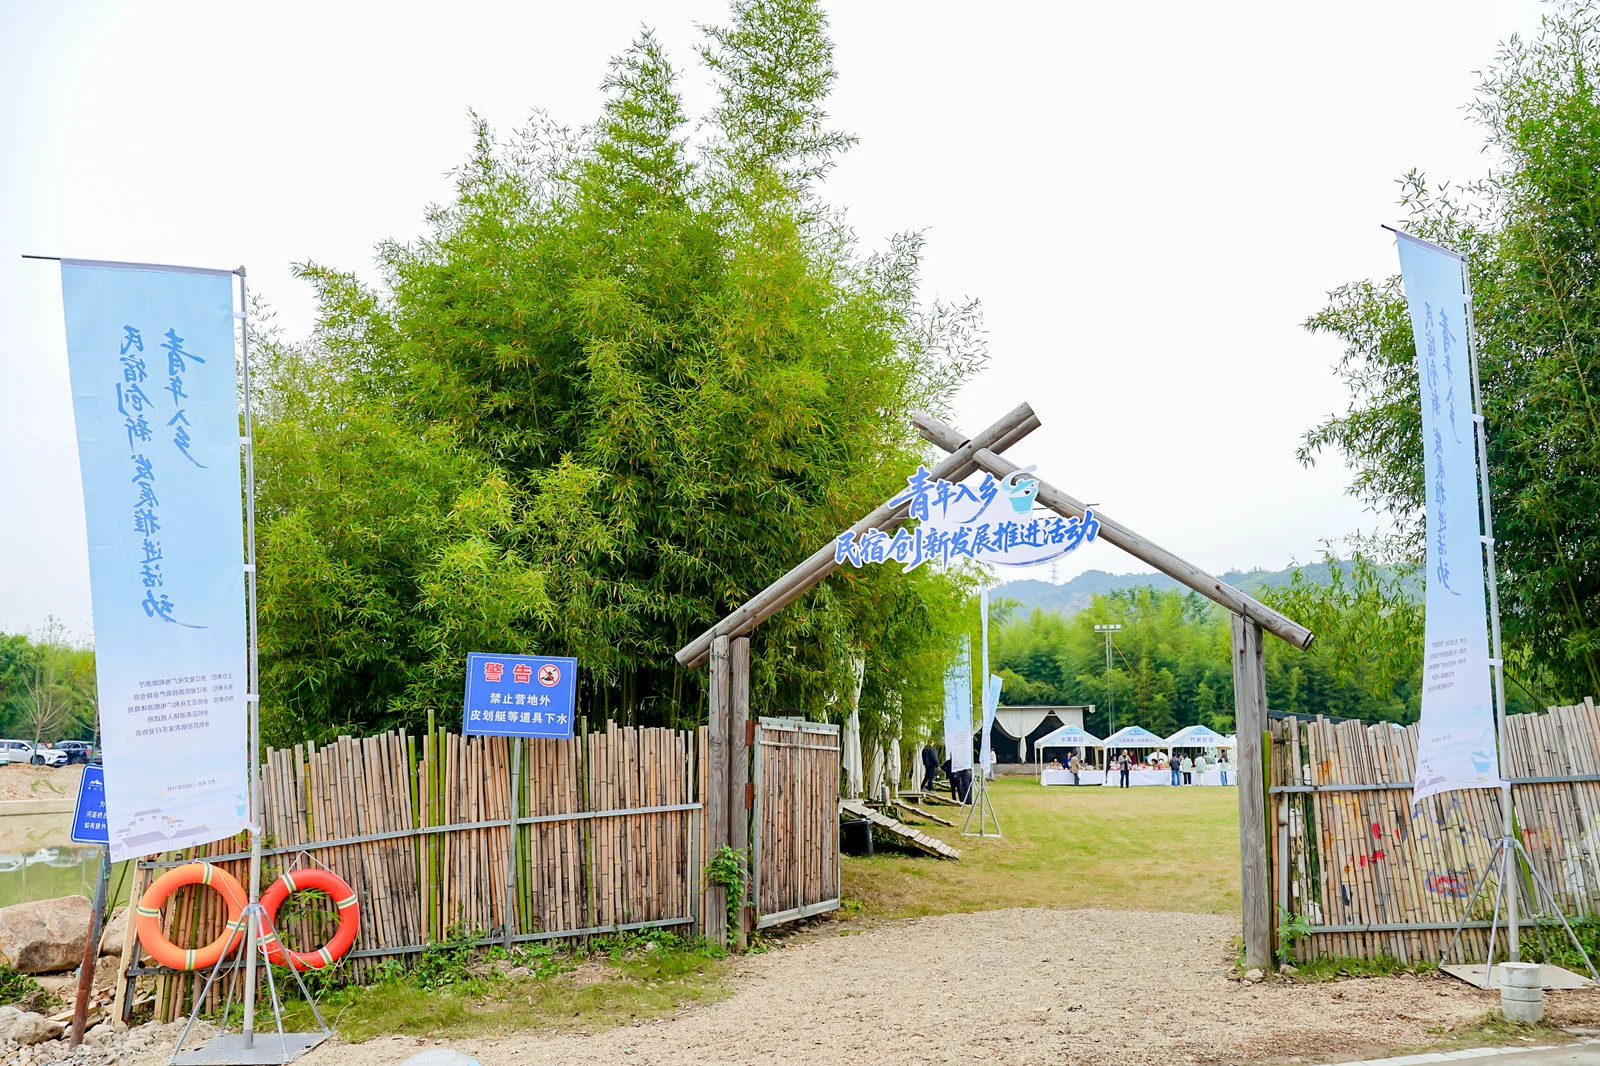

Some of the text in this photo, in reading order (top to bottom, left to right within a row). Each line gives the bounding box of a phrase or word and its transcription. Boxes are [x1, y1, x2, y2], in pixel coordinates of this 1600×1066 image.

[888, 467, 998, 523] 青年入乡
[836, 510, 1100, 572] 民宿创新发展推进活动
[485, 662, 531, 683] 警告
[490, 692, 551, 706] 禁止营地外
[470, 709, 568, 725] 皮划艇等道具下水
